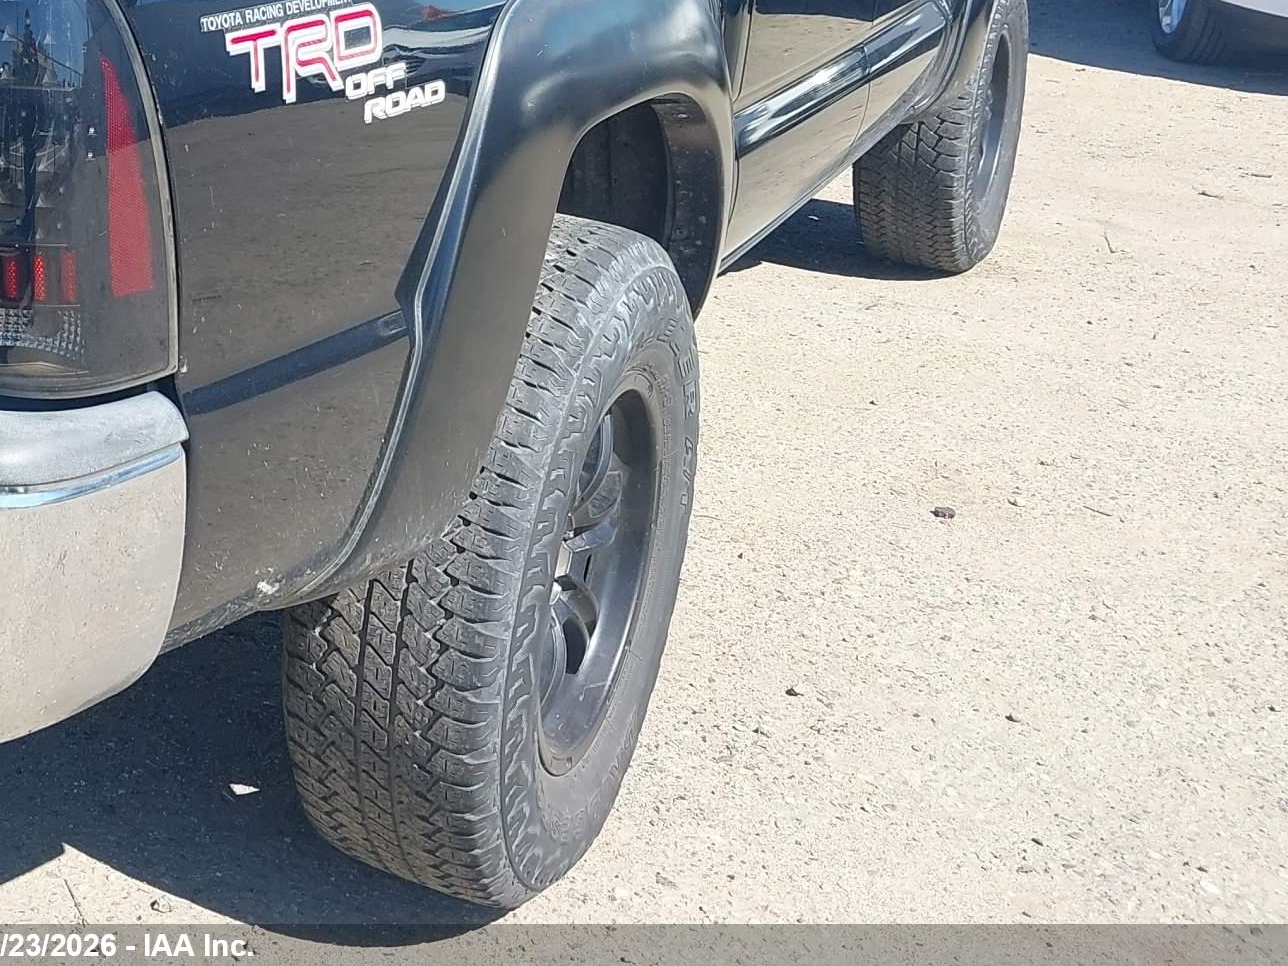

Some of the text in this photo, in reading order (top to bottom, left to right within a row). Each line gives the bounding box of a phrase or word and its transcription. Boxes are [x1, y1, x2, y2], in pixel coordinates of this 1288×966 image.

[201, 13, 243, 32] TOYOTA
[245, 0, 284, 23] RACING
[224, 2, 384, 104] TRD
[344, 61, 409, 101] OFF
[363, 79, 446, 124] ROAD
